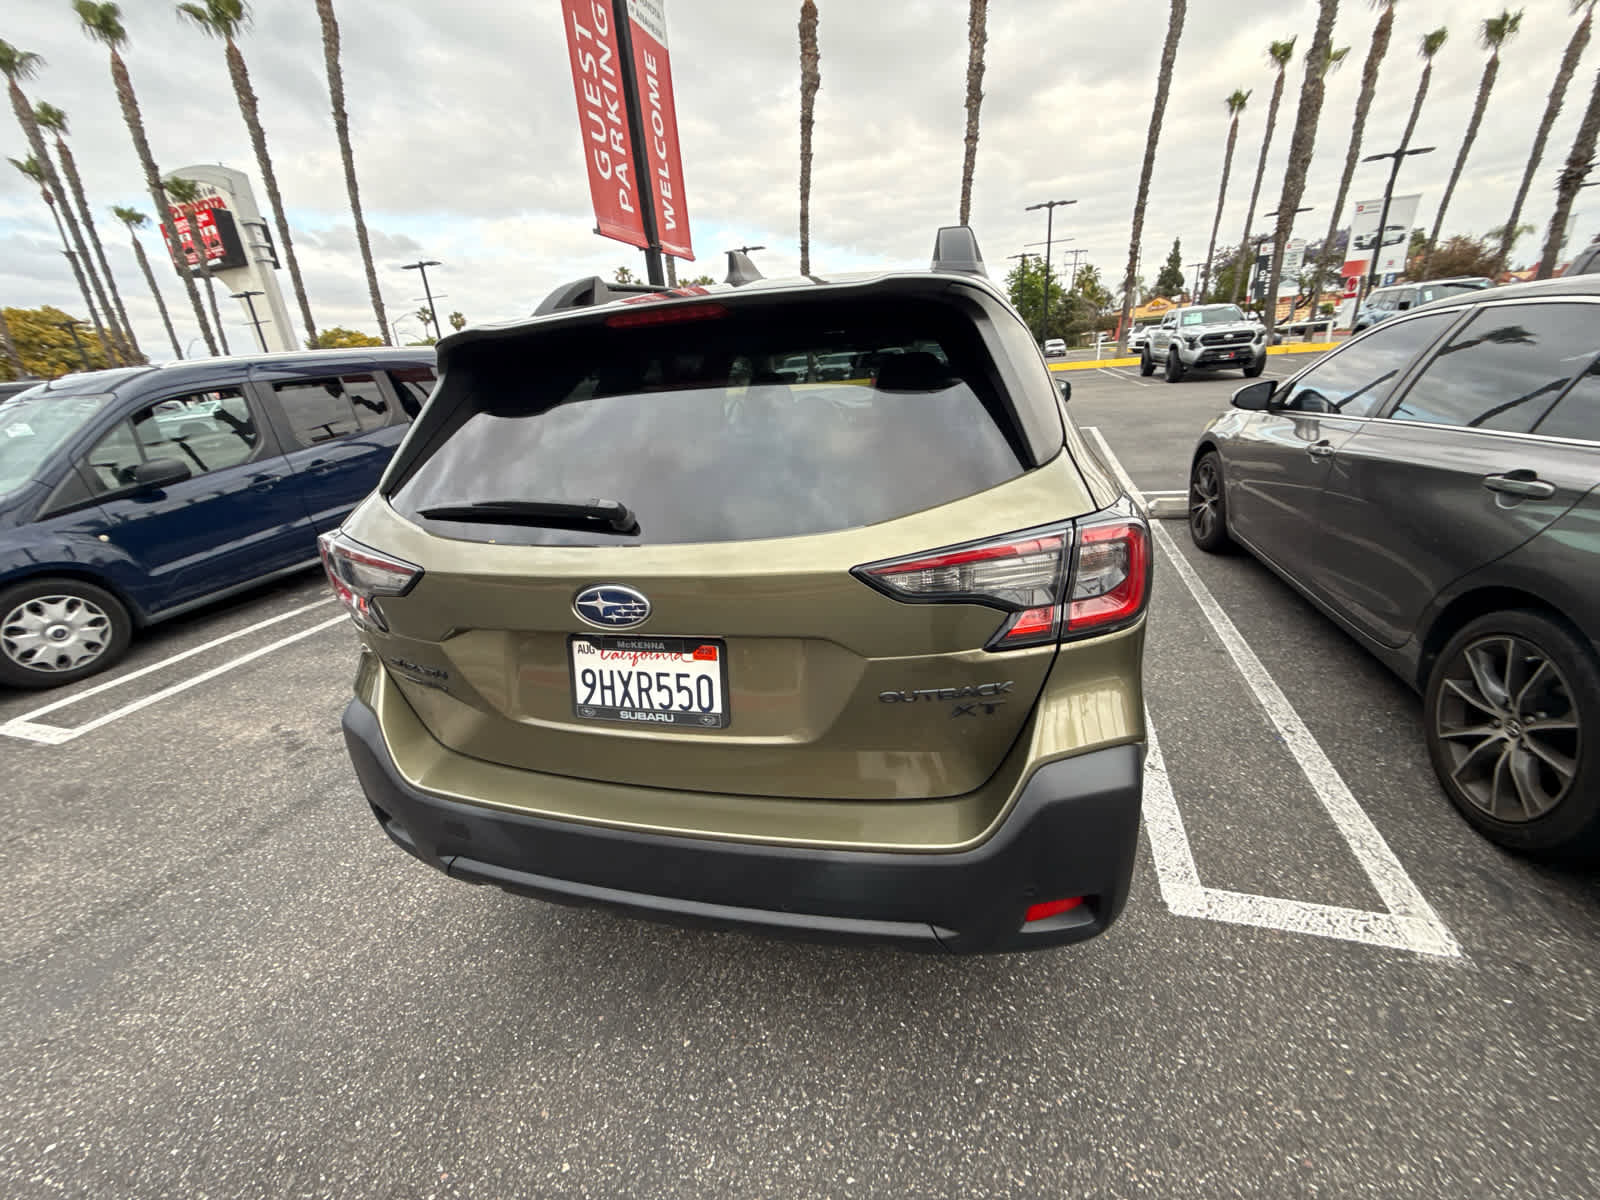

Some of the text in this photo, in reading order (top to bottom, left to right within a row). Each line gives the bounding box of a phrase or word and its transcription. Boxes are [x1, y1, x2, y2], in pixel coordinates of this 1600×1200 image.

[572, 9, 612, 181] GUEST
[591, 0, 635, 214] PARKING
[643, 49, 677, 231] WELCOME
[577, 643, 596, 655] AUG
[616, 640, 665, 650] McKENNA
[581, 667, 715, 713] 9HXR550
[879, 680, 1015, 704] OUTBACK
[619, 710, 675, 723] SUBARU
[951, 699, 1007, 719] XT
